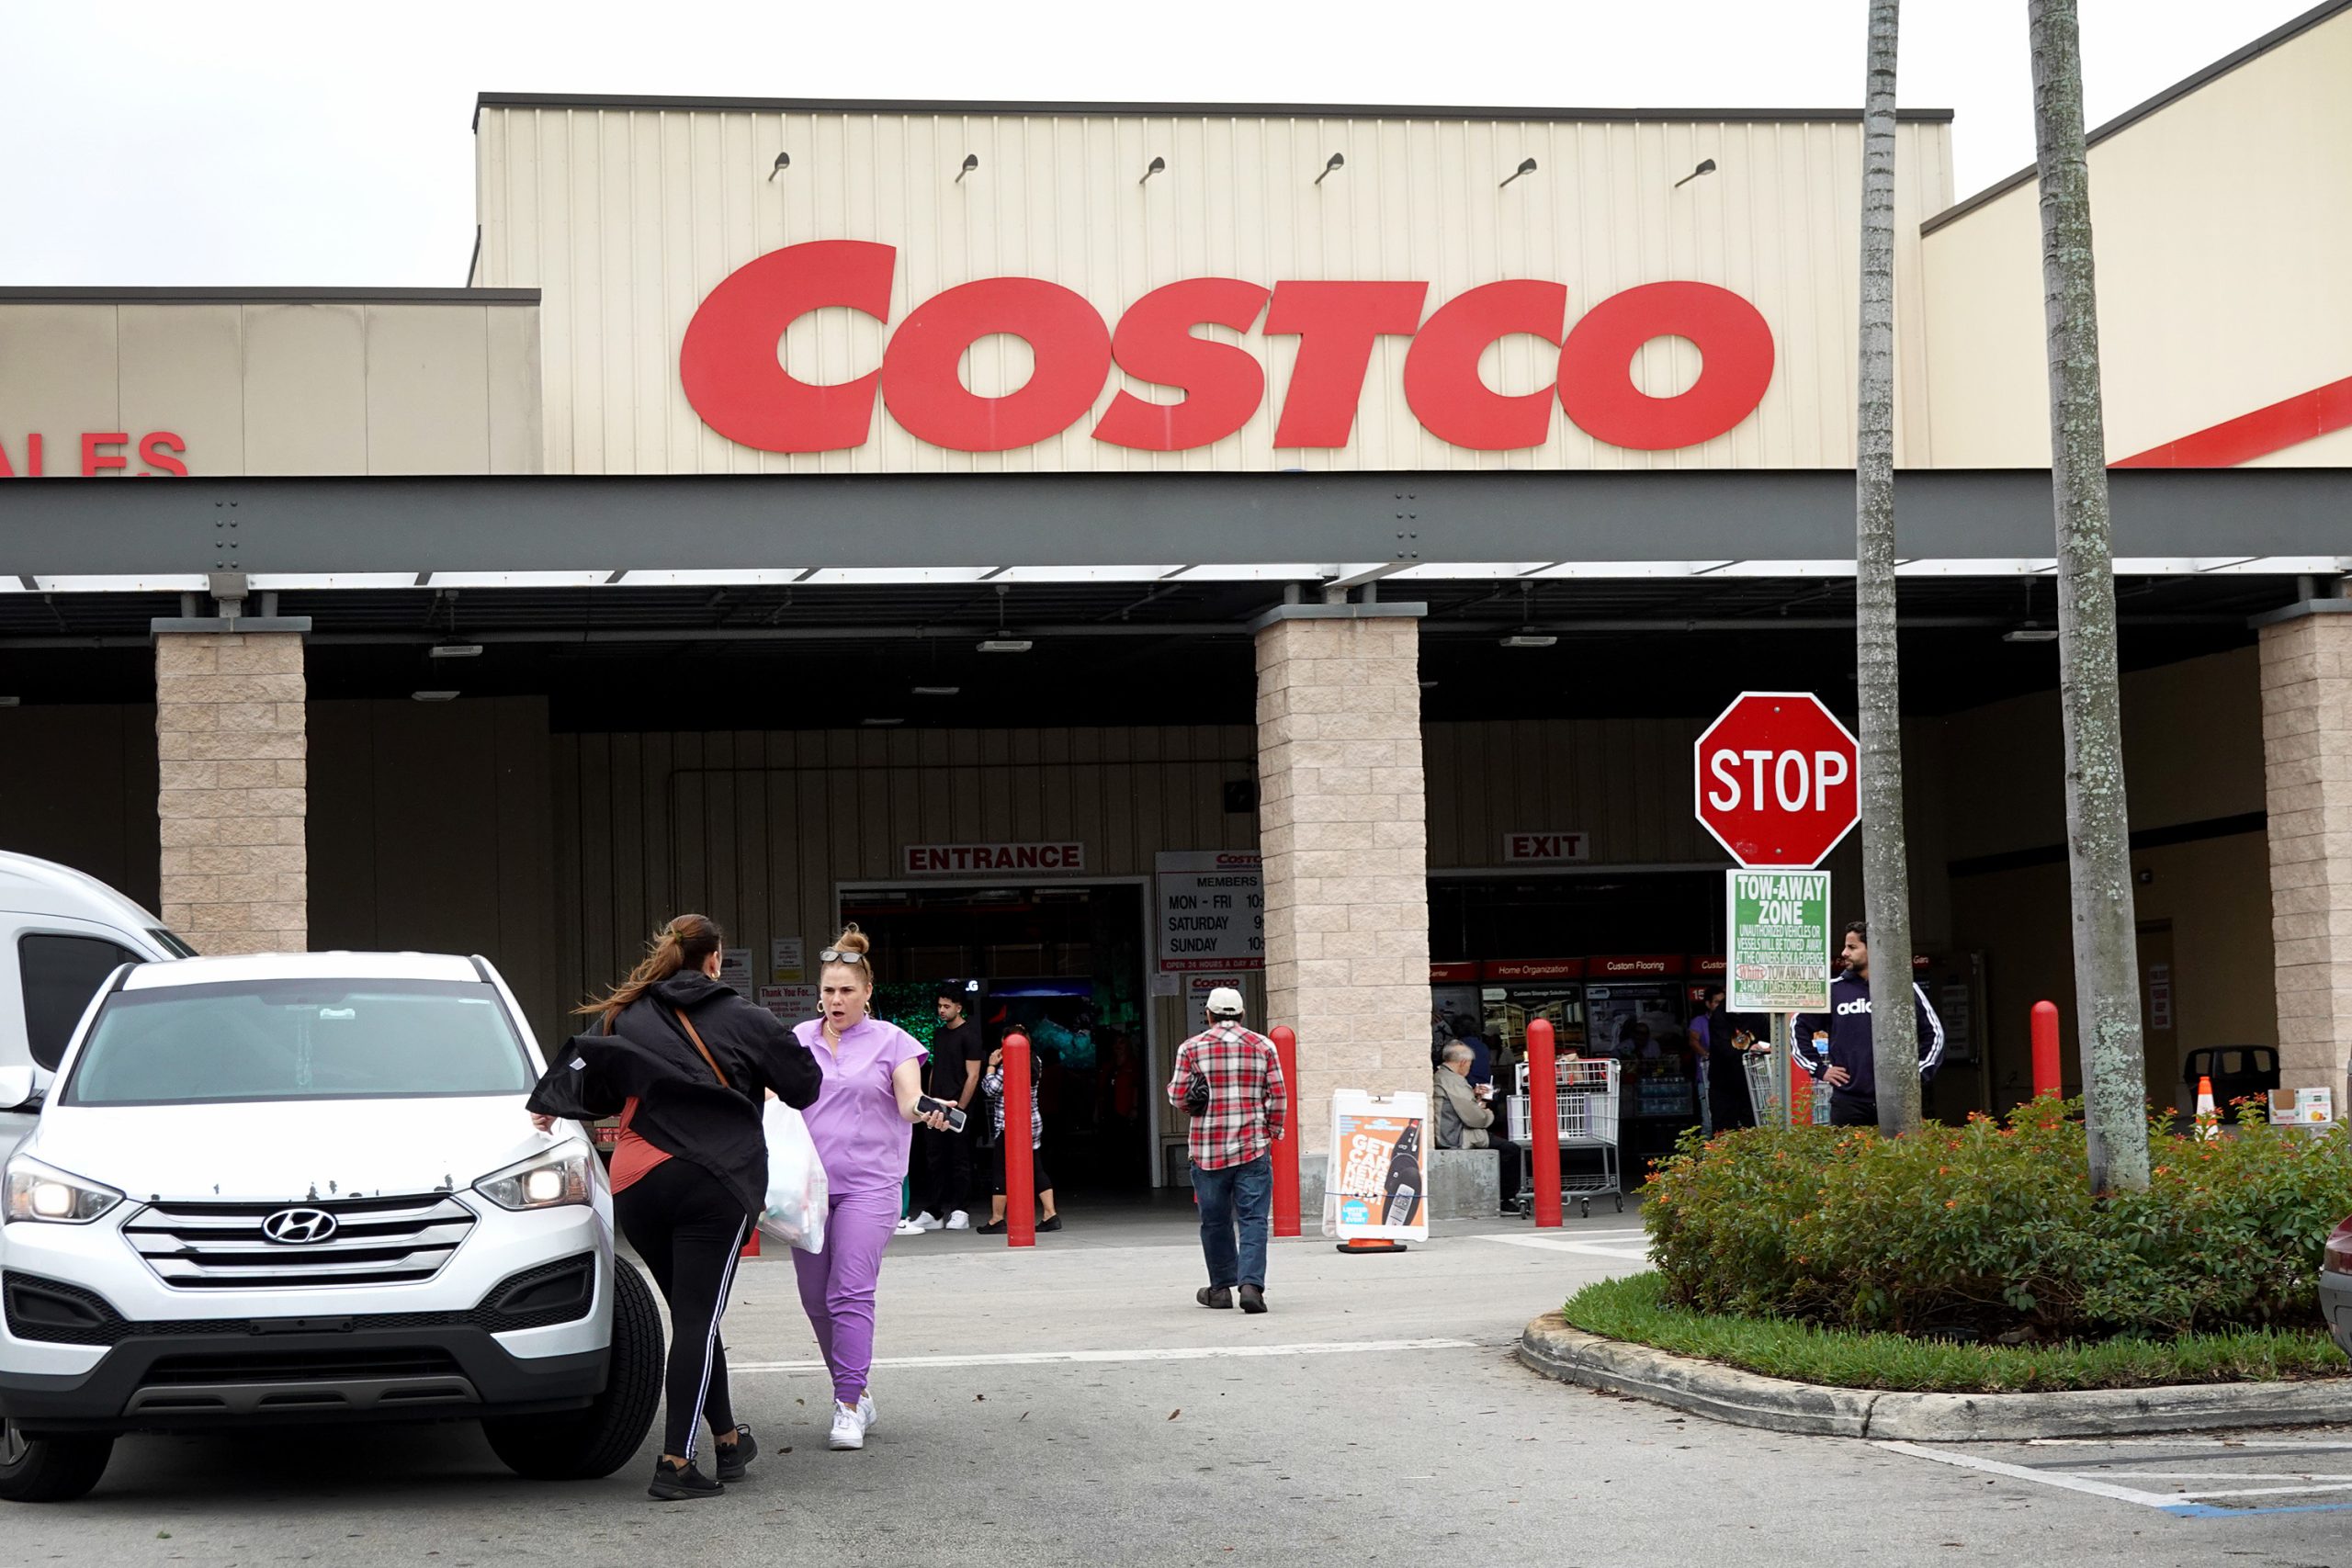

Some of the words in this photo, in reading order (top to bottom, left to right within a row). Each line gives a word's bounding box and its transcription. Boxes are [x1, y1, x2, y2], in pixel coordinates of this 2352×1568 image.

[680, 239, 1775, 454] COSTCO
[1708, 749, 1848, 812] STOP
[1512, 836, 1580, 857] EXIT
[909, 845, 1080, 870] ENTRANCE
[1216, 854, 1262, 863] COSTC
[1197, 876, 1258, 887] MEMBERS
[1737, 875, 1825, 901] TOW-AWAY
[1169, 896, 1197, 909] MON
[1214, 895, 1231, 908] FRI
[1247, 894, 1264, 908] 10:
[1758, 900, 1804, 925] ZONE
[1169, 917, 1228, 931] SATURDAY
[1739, 924, 1784, 937] UNAUTHORIZED
[1785, 925, 1812, 937] VEHICLES
[1812, 925, 1820, 938] OR
[1170, 938, 1217, 953] SUNDAY
[1248, 937, 1264, 951] 10:
[1737, 938, 1760, 950] VESSELS
[1760, 938, 1775, 951] WILL
[1775, 939, 1783, 951] BE
[1783, 939, 1804, 951] TOWED
[1806, 939, 1823, 951] AWAY
[1736, 951, 1743, 963] AT
[1743, 951, 1755, 964] THE
[1781, 952, 1793, 964] RISK
[1799, 952, 1825, 964] EXPENSE
[1498, 965, 1521, 975] Home
[1522, 964, 1569, 976] Organization
[1607, 962, 1634, 971] Custom
[1635, 961, 1665, 972] Flooring
[1767, 965, 1785, 979] TOW
[1785, 965, 1807, 980] AWAY
[1193, 978, 1240, 987] COSTCO
[762, 988, 783, 997] Thank
[783, 987, 797, 997] You
[1351, 1134, 1395, 1157] GET
[1349, 1148, 1390, 1172] CAR
[1346, 1161, 1389, 1183] KEYS
[1342, 1171, 1385, 1194] HERE
